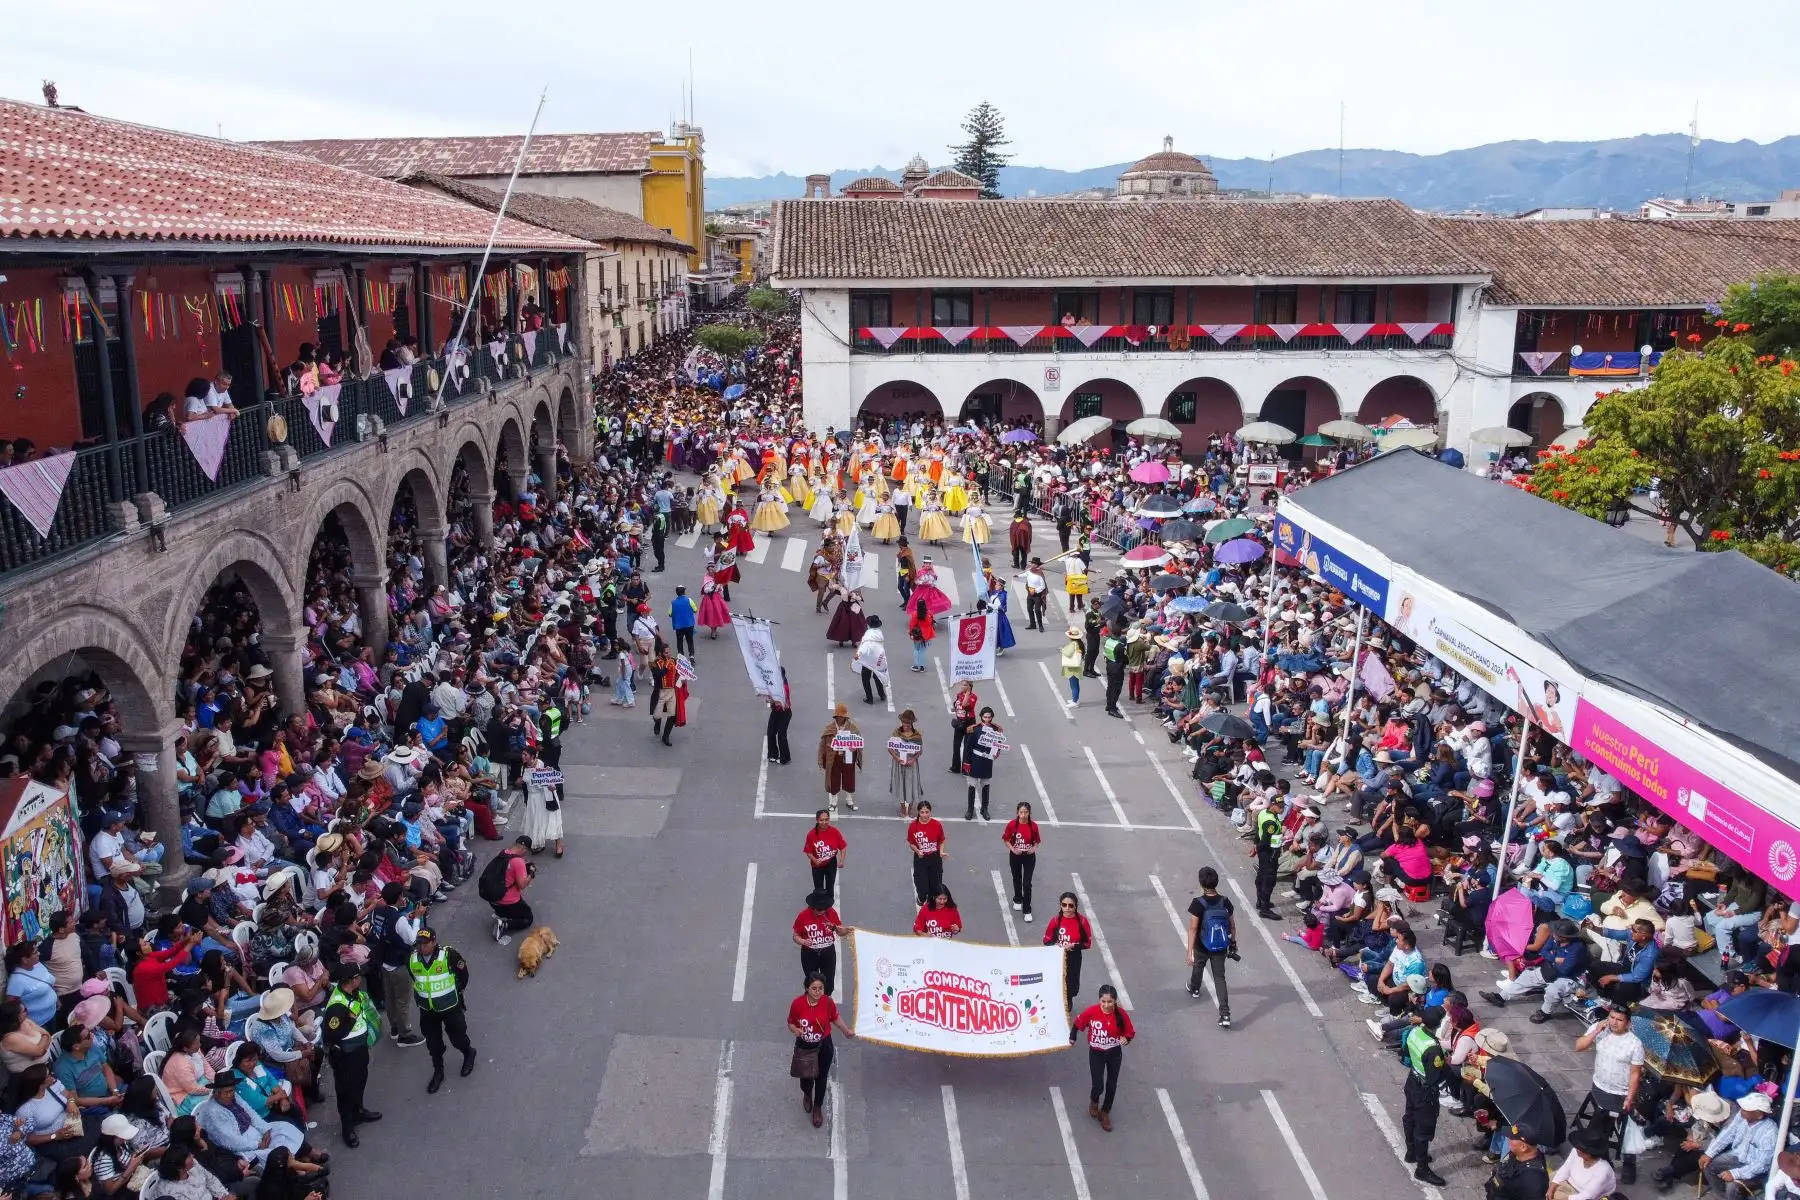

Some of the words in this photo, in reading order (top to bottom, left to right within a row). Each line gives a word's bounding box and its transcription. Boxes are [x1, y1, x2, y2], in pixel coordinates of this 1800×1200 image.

[1434, 626, 1457, 646] CARNAVAL
[1491, 663, 1504, 676] 2024
[832, 740, 863, 748] Auqui
[888, 741, 920, 751] Rabona
[1592, 723, 1628, 756] Nuestro
[1629, 745, 1659, 776] Perú
[532, 770, 561, 779] Parado
[1585, 736, 1591, 748] lo
[1591, 741, 1641, 782] construimos
[1642, 773, 1668, 800] todos
[1707, 810, 1728, 828] Ministerio
[1728, 824, 1734, 832] de
[1734, 827, 1751, 842] Cultura
[812, 936, 834, 944] ARIOS
[925, 972, 990, 997] COMPARSA
[900, 991, 1018, 1031] BICENTENARIO
[1090, 1020, 1102, 1029] VO
